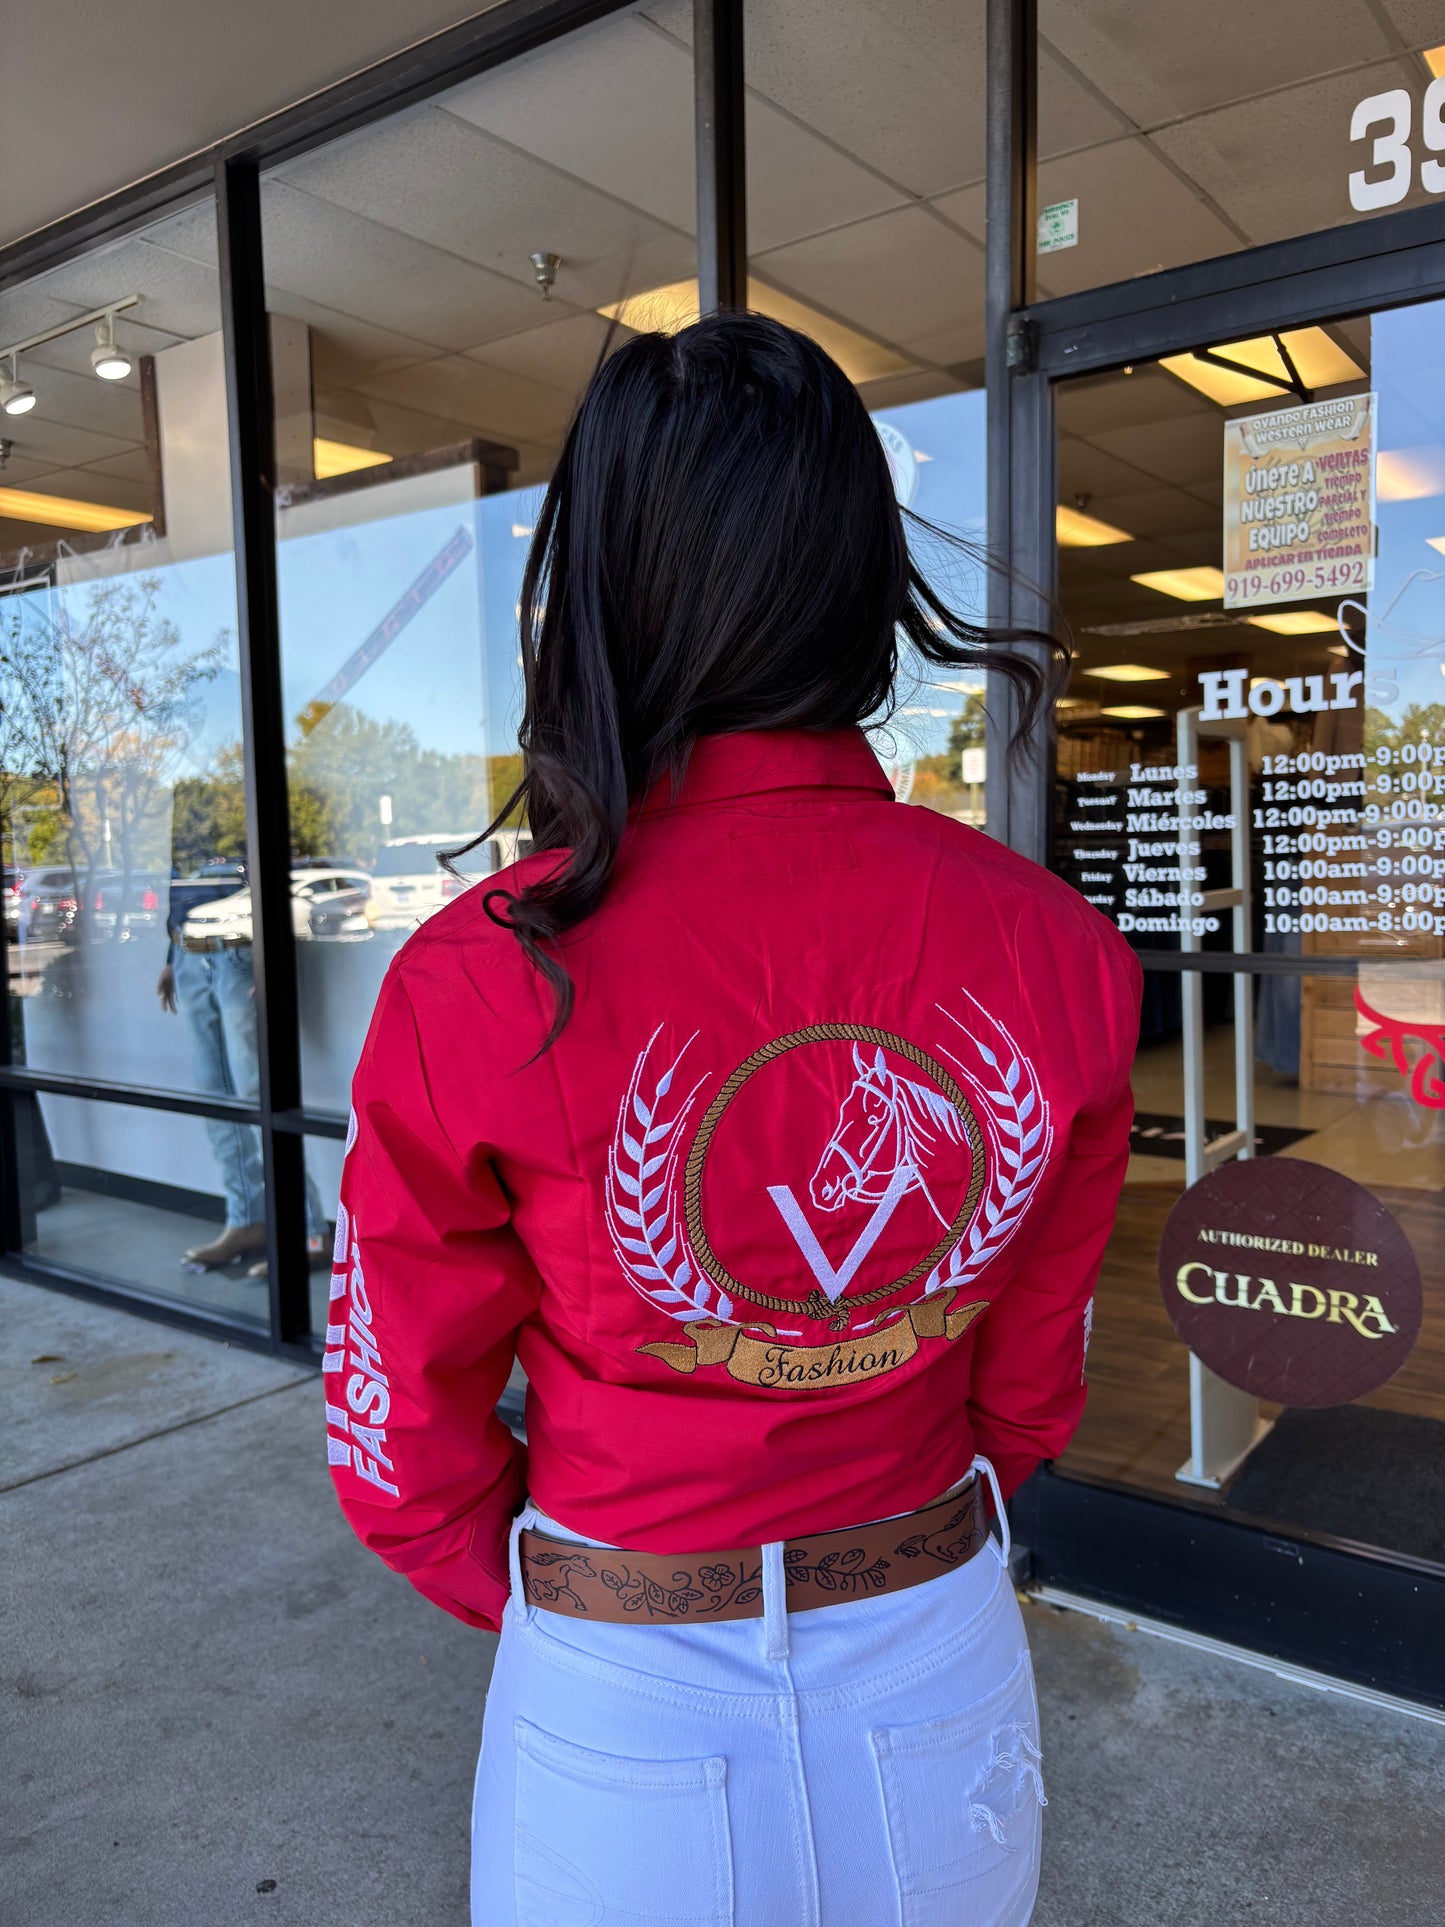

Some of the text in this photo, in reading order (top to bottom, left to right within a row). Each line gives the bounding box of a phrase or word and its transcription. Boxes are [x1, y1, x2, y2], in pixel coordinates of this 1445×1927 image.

[1301, 459, 1316, 485] A
[1249, 521, 1310, 552] EQUIPO
[1227, 561, 1364, 599] 919-699-5492
[1198, 668, 1400, 721] Hours
[1129, 763, 1199, 782] Lunes
[1262, 742, 1445, 775] 12:00pm-9:00p
[1127, 788, 1208, 808] Martes
[1262, 771, 1445, 803] 12:00pm-9:00p
[1126, 810, 1238, 833] Miércoles
[1127, 838, 1201, 862] Jueves
[1262, 827, 1445, 857] 12:00pm-9:00p
[1081, 854, 1445, 884] Friday Viernes 10:00am-9:00p
[1125, 888, 1205, 908] Sábado
[1263, 882, 1445, 908] 10:00am-9:00p
[1117, 910, 1445, 937] Domingo 10:00am-8:00p
[1197, 1229, 1379, 1267] AUTHORIZED DEALER
[1176, 1261, 1397, 1340] CUADRA
[346, 1214, 400, 1498] FASHIO
[757, 1342, 904, 1388] Fashion
